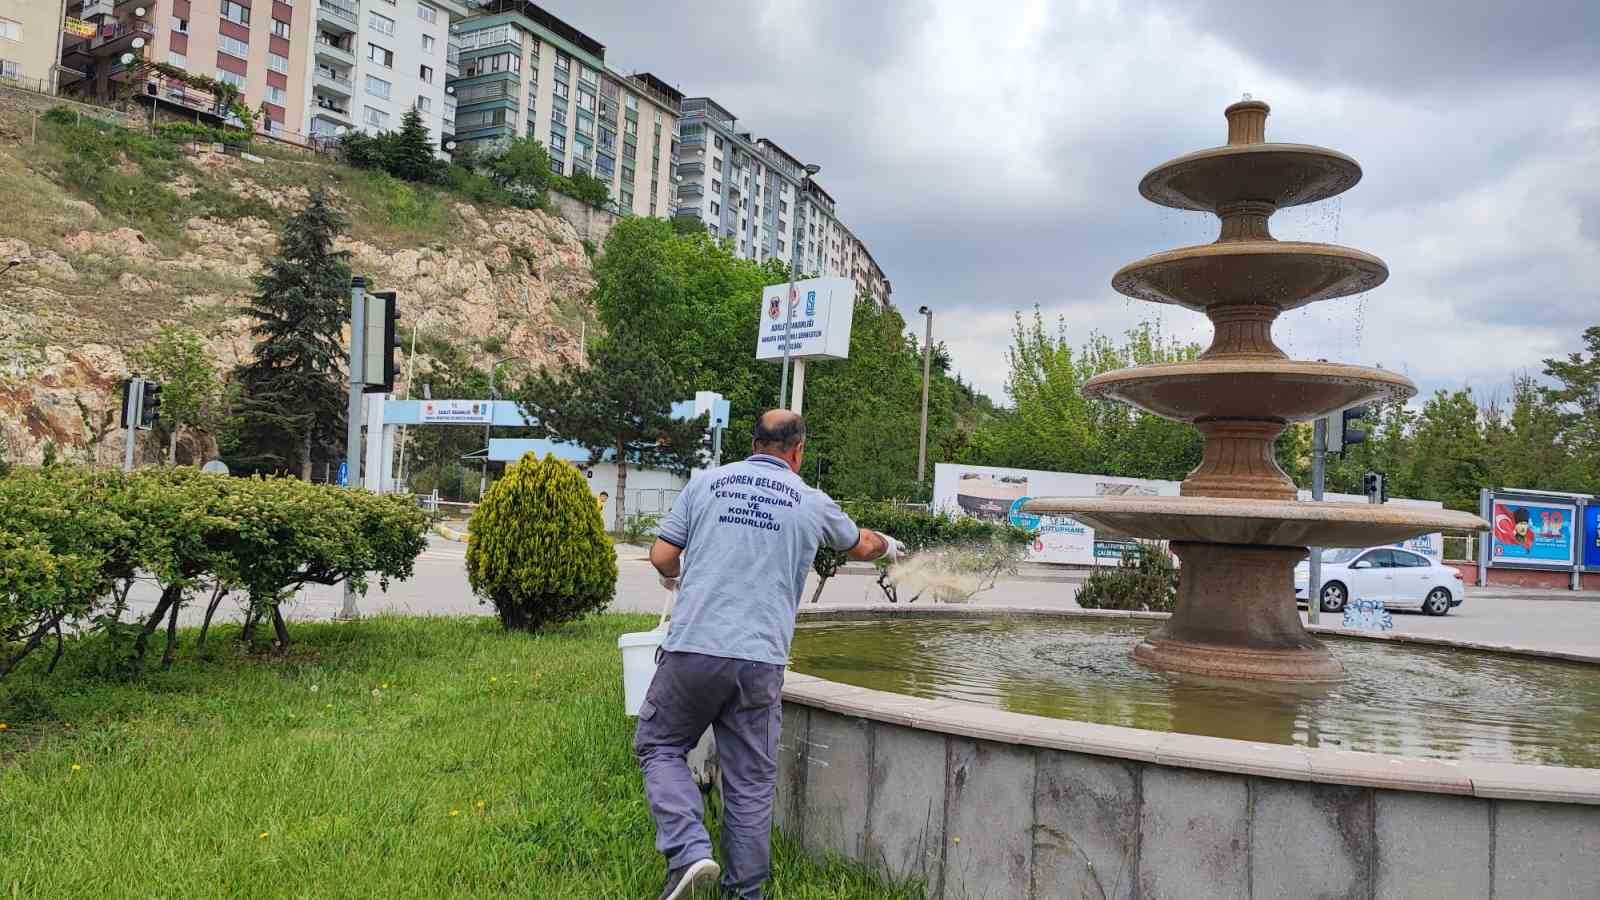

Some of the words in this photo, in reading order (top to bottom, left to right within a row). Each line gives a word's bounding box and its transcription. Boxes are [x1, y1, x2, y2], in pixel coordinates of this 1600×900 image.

[747, 502, 760, 511] VE
[750, 495, 793, 509] KORUMA
[728, 506, 774, 521] KONTROL
[719, 514, 780, 531] MÜDÜRLÜĞÜ
